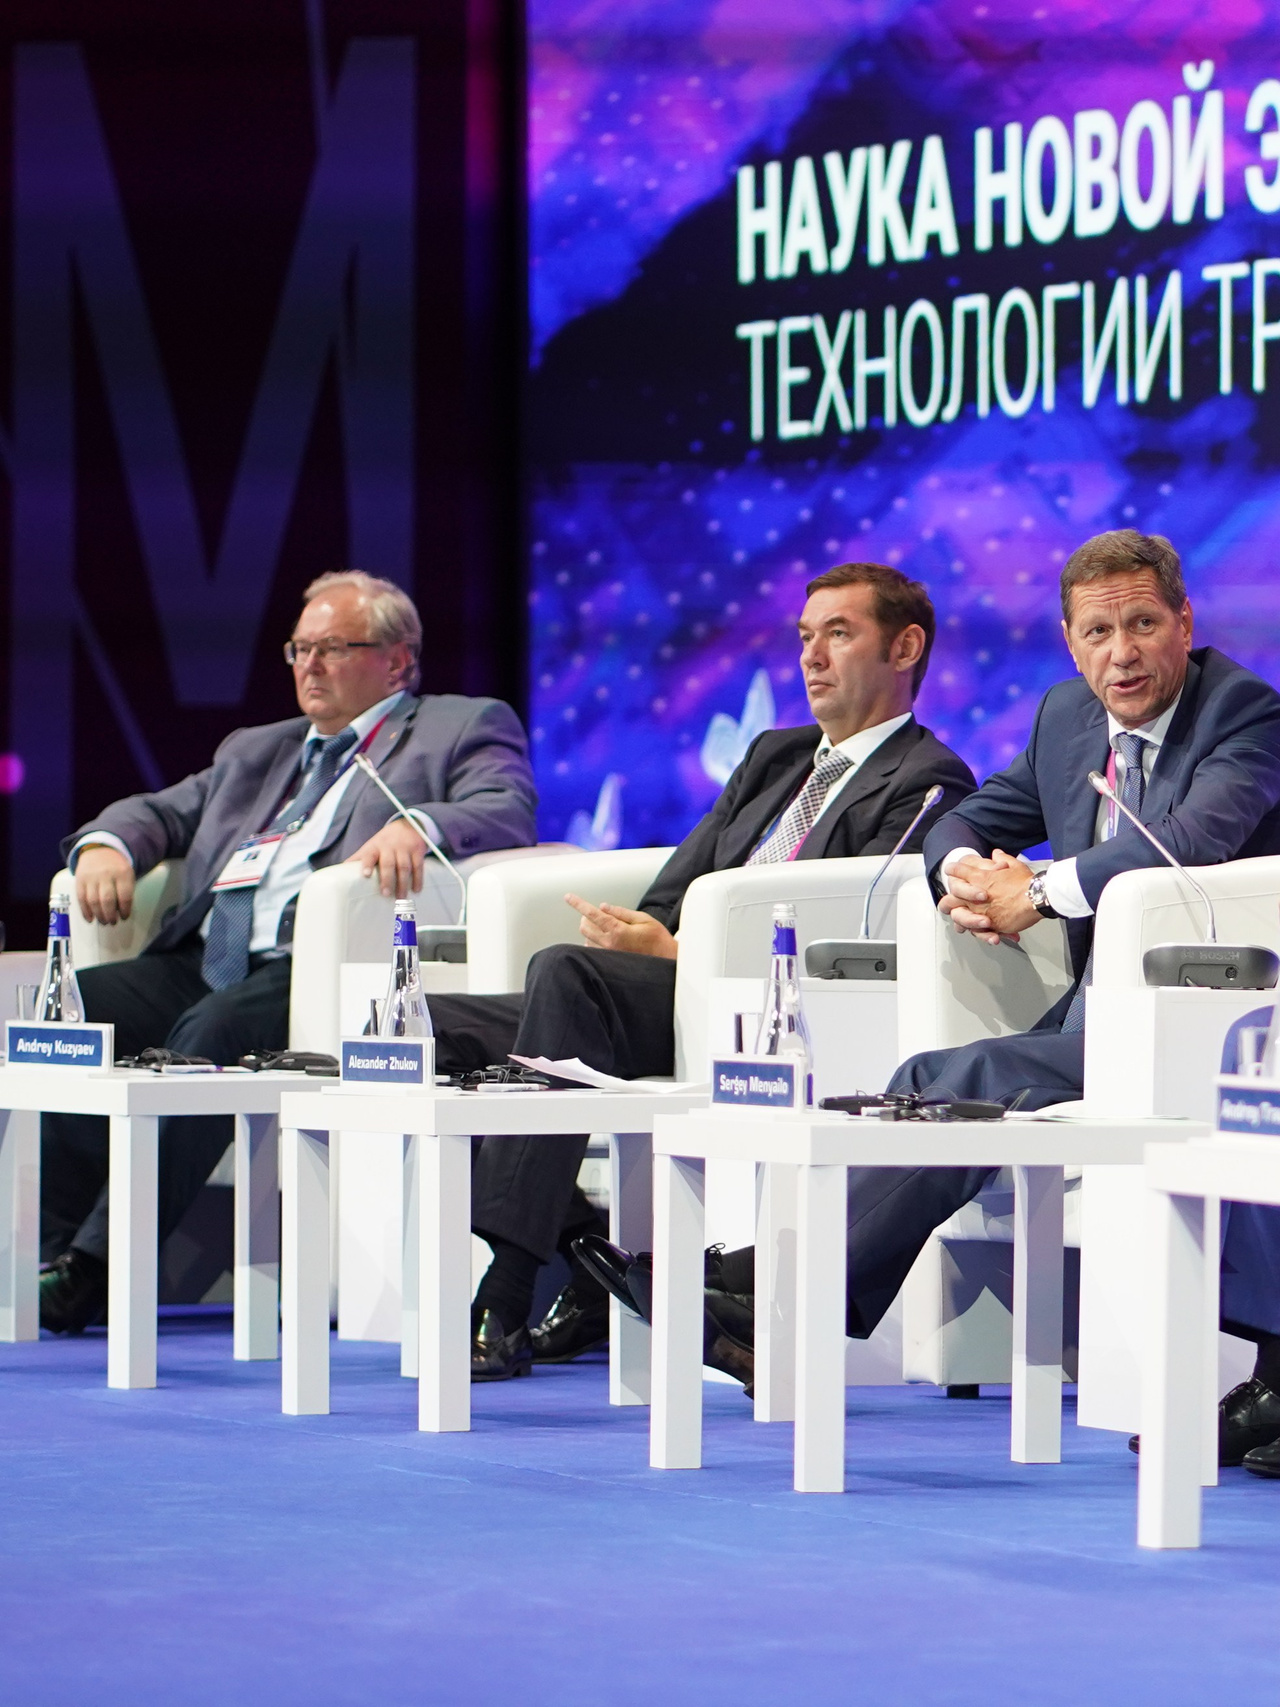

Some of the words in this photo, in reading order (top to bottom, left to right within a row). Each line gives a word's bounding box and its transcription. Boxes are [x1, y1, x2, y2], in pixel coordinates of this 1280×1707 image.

[736, 134, 959, 284] НАУКА
[974, 59, 1224, 252] НОВОЙ
[735, 270, 1183, 441] ТЕХНОЛОГИИ
[16, 1037, 53, 1057] Andrey
[54, 1039, 95, 1058] Kuzyaev
[348, 1055, 388, 1070] Alexander
[389, 1056, 418, 1071] Zhukov
[719, 1074, 748, 1096] Sergey
[749, 1076, 789, 1098] Menyailo
